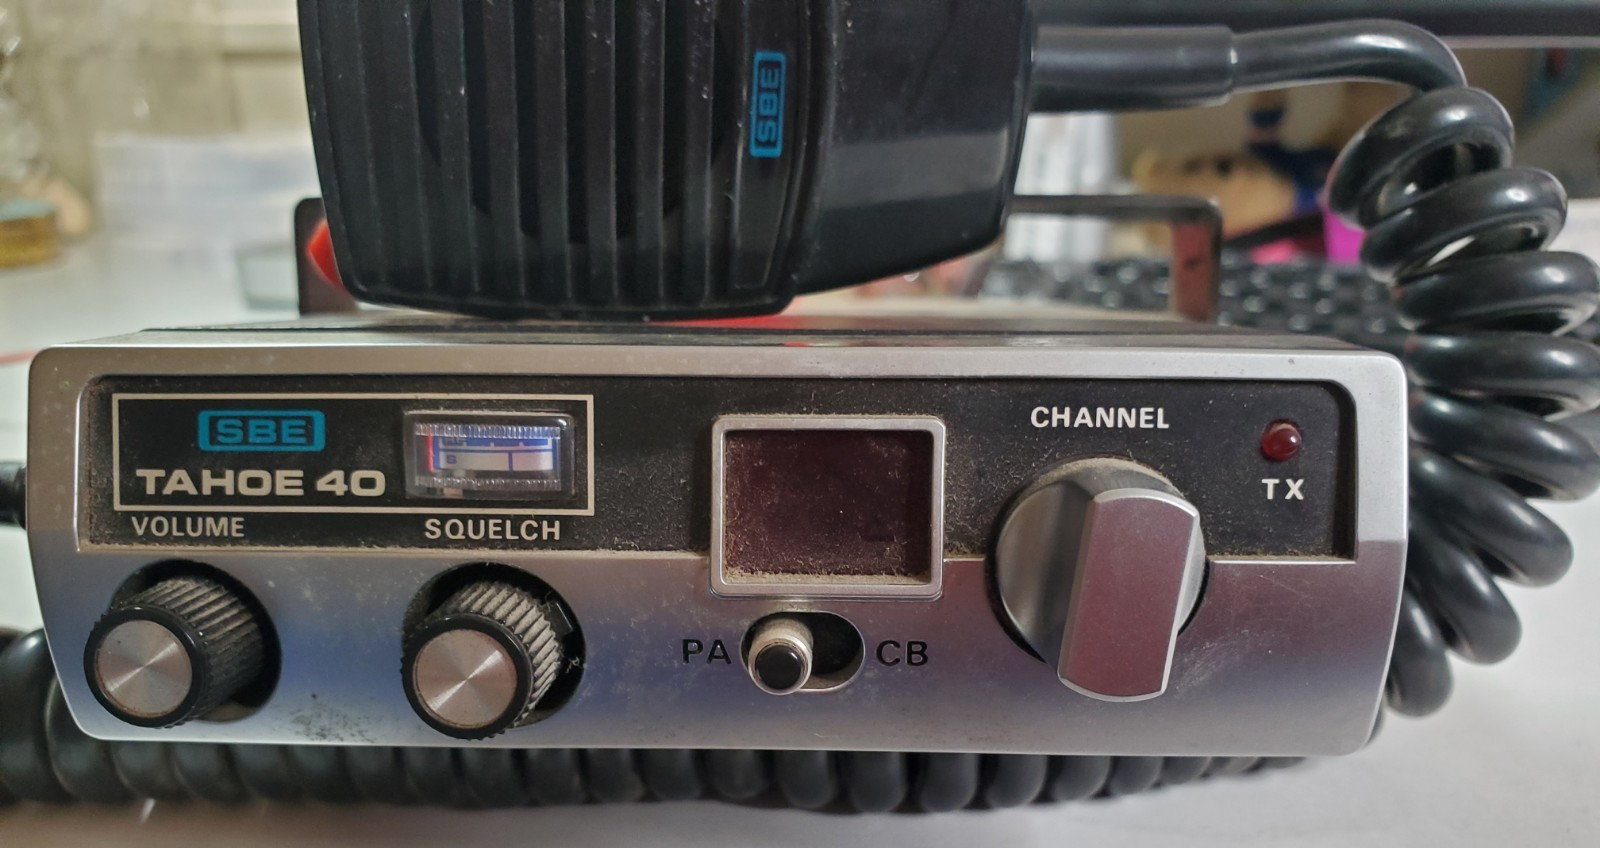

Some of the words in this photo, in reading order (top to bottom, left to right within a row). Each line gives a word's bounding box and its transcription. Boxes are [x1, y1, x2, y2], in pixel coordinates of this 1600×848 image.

[757, 67, 780, 143] SBE
[1030, 406, 1170, 429] CHANNEL
[216, 418, 307, 444] SBE
[135, 469, 305, 496] TAHOE
[316, 469, 386, 497] 40
[1261, 478, 1304, 501] TX
[131, 516, 245, 538] VOLUME
[424, 518, 561, 541] SQUELCH
[682, 638, 732, 665] PA
[876, 639, 929, 667] CB
